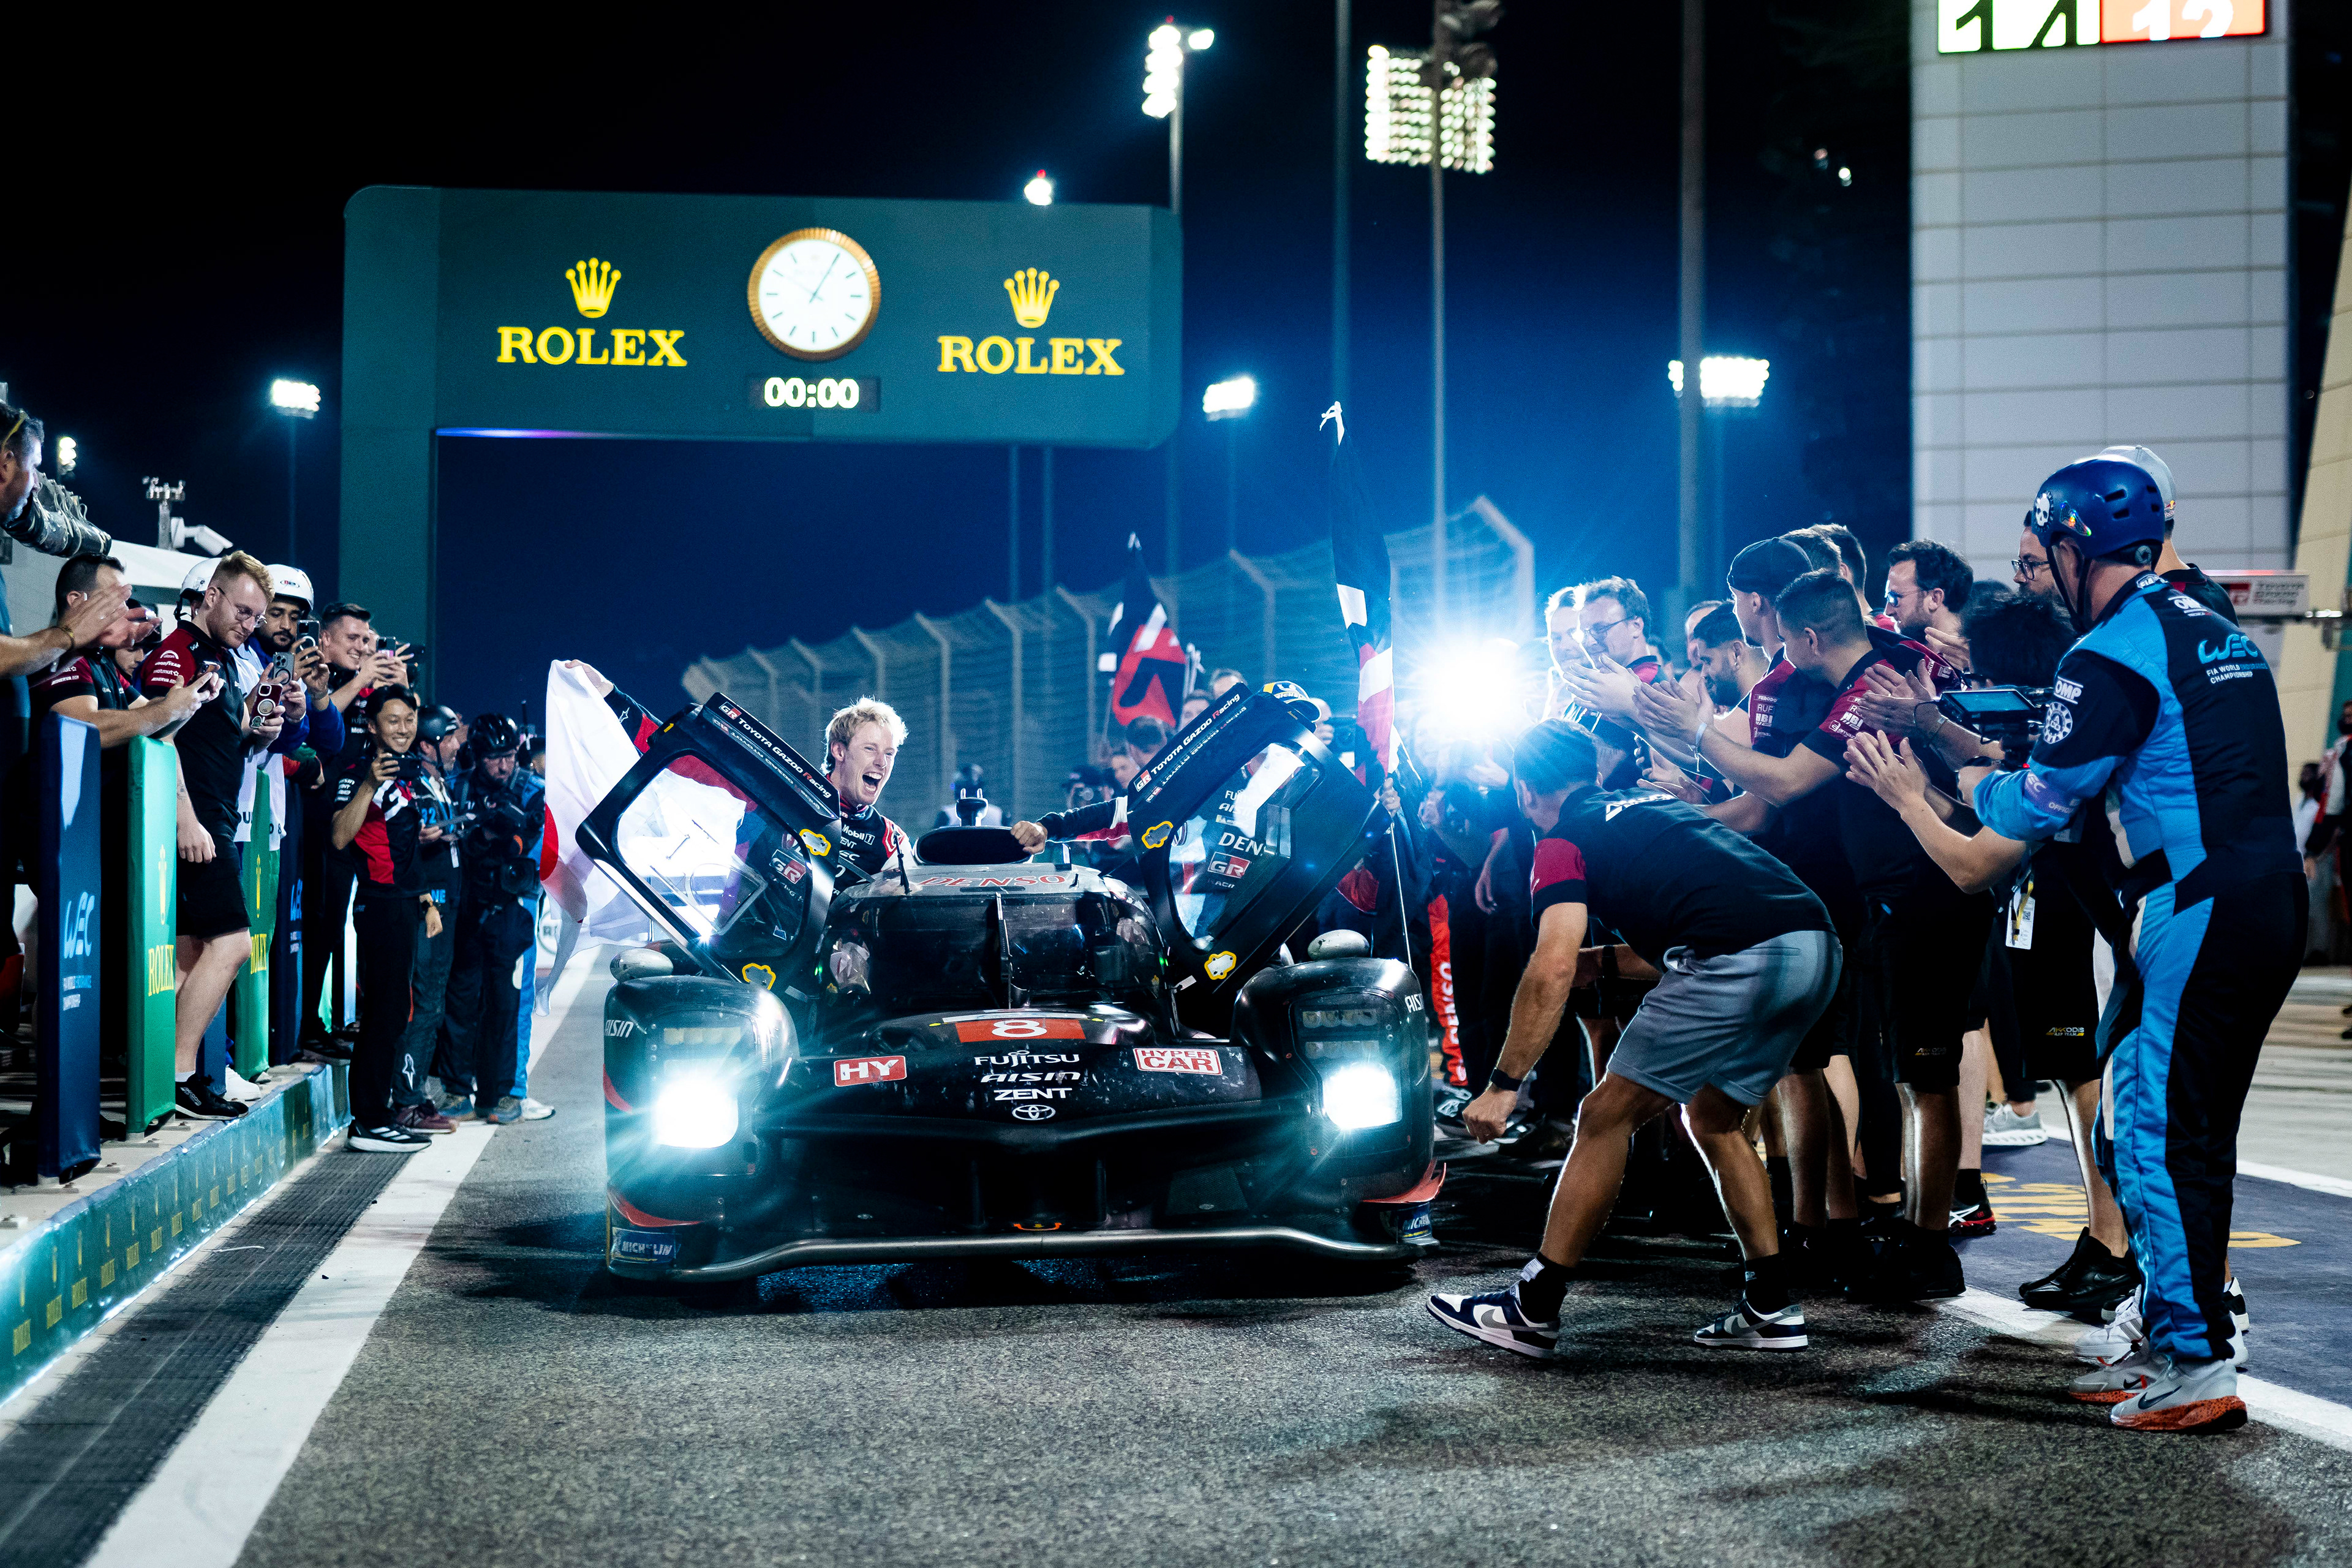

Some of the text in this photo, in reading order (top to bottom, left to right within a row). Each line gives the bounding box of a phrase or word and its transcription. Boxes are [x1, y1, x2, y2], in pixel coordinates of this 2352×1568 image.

[497, 326, 688, 366] ROLEX
[937, 336, 1125, 375] ROLEX
[764, 377, 860, 409] 00:00
[2198, 633, 2259, 665] WEC
[51, 676, 72, 685] MINERVA
[2206, 668, 2219, 677] FIA
[2218, 664, 2241, 673] WORLD
[2210, 671, 2253, 684] CHAMPIONSHIP
[2055, 679, 2082, 700] OMP
[720, 704, 738, 719] GR
[738, 717, 772, 748] TOYOTA
[772, 746, 804, 774] GAZOO
[802, 772, 832, 799] Racing
[1136, 773, 1152, 791] GR
[1151, 745, 1183, 775] TOYOTA
[1183, 718, 1213, 746] GAZOO
[1212, 694, 1240, 720] Racing
[843, 824, 865, 841] Mobil
[1218, 832, 1264, 856] DEN
[772, 858, 803, 882] GR
[1210, 861, 1244, 878] GR
[919, 875, 1066, 888] DENSO
[63, 891, 95, 959] WEC
[148, 944, 174, 997] ROLEX
[992, 1019, 1048, 1038] 8
[974, 1050, 1080, 1068] FUJITSU
[1142, 1050, 1211, 1058] HYPER
[1144, 1057, 1214, 1071] CAR
[840, 1058, 901, 1081] HY
[980, 1071, 1081, 1083] AISIN
[993, 1087, 1073, 1101] ZENT
